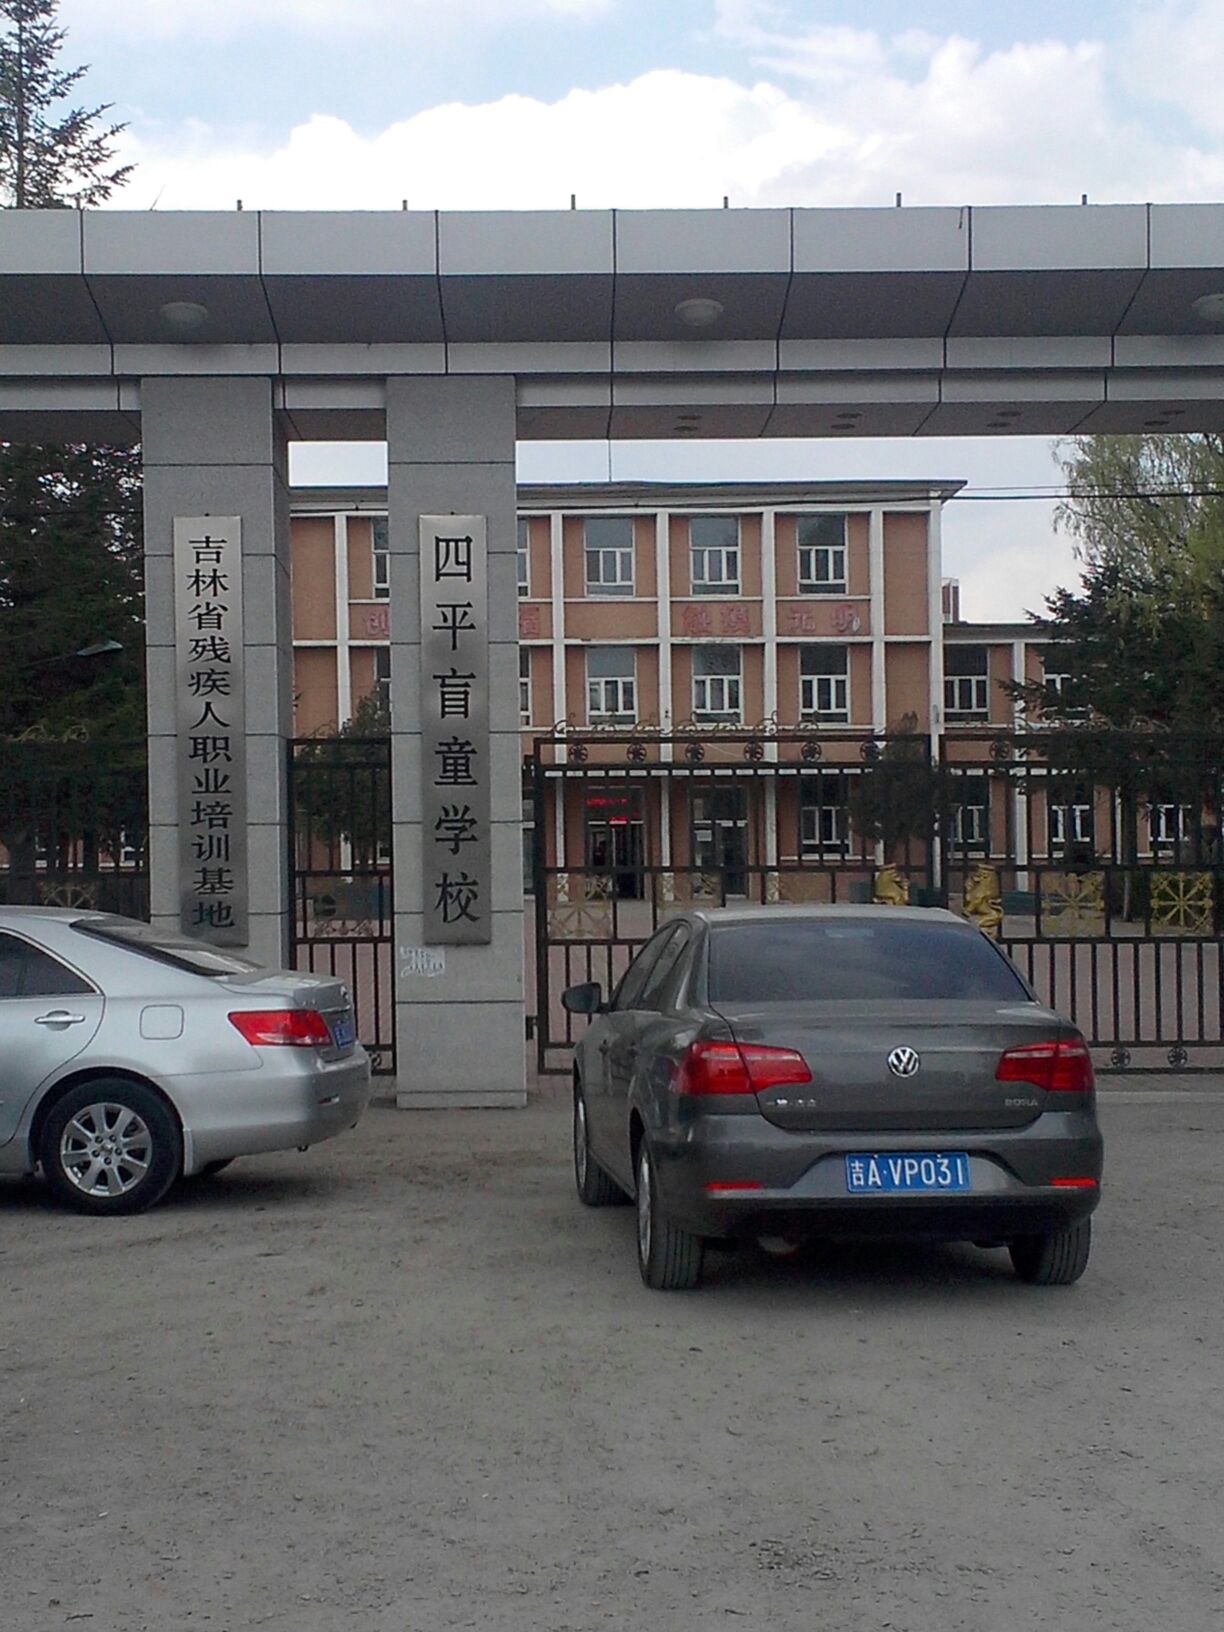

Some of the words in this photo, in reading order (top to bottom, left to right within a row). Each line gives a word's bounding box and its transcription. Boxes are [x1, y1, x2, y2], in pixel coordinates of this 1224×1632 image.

[187, 535, 236, 929] 吉林省残疾人职业培训基地
[433, 535, 480, 925] 四平盲童学校
